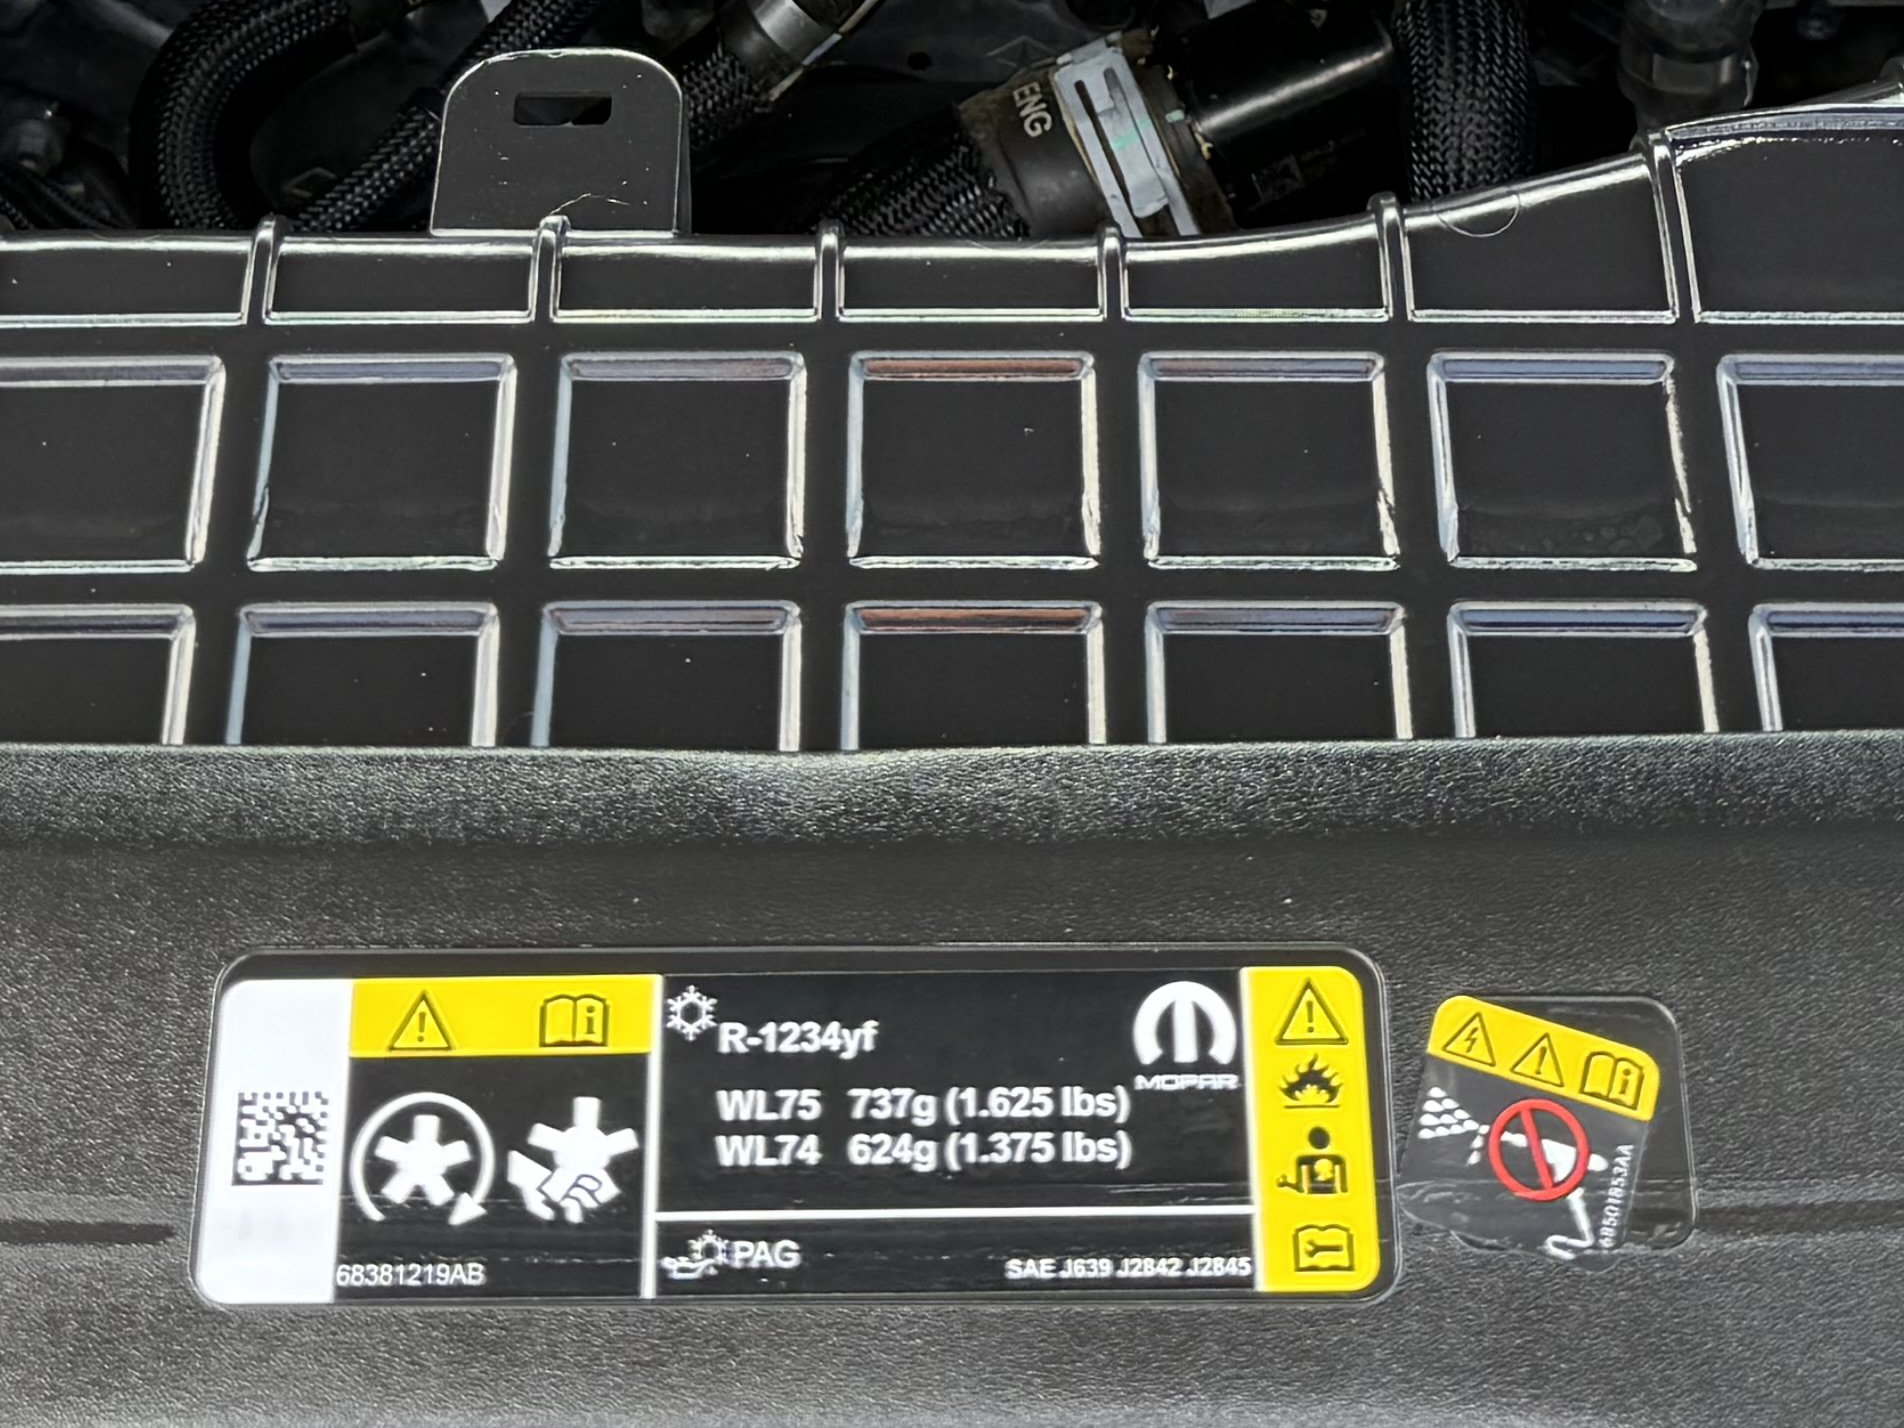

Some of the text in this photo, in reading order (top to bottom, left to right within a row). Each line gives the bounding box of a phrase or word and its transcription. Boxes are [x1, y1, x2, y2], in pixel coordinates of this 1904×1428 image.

[1012, 80, 1054, 138] ENG
[717, 1019, 879, 1059] R-1234yf
[716, 1084, 1132, 1127] WL75 737g (1.625 lbs)
[716, 1130, 1133, 1172] WL74 624g (1.375 lbs)
[336, 1261, 487, 1287] 68381219AB
[732, 1240, 801, 1269] PAG
[1005, 1254, 1253, 1280] SAE J639 J2842 J2845
